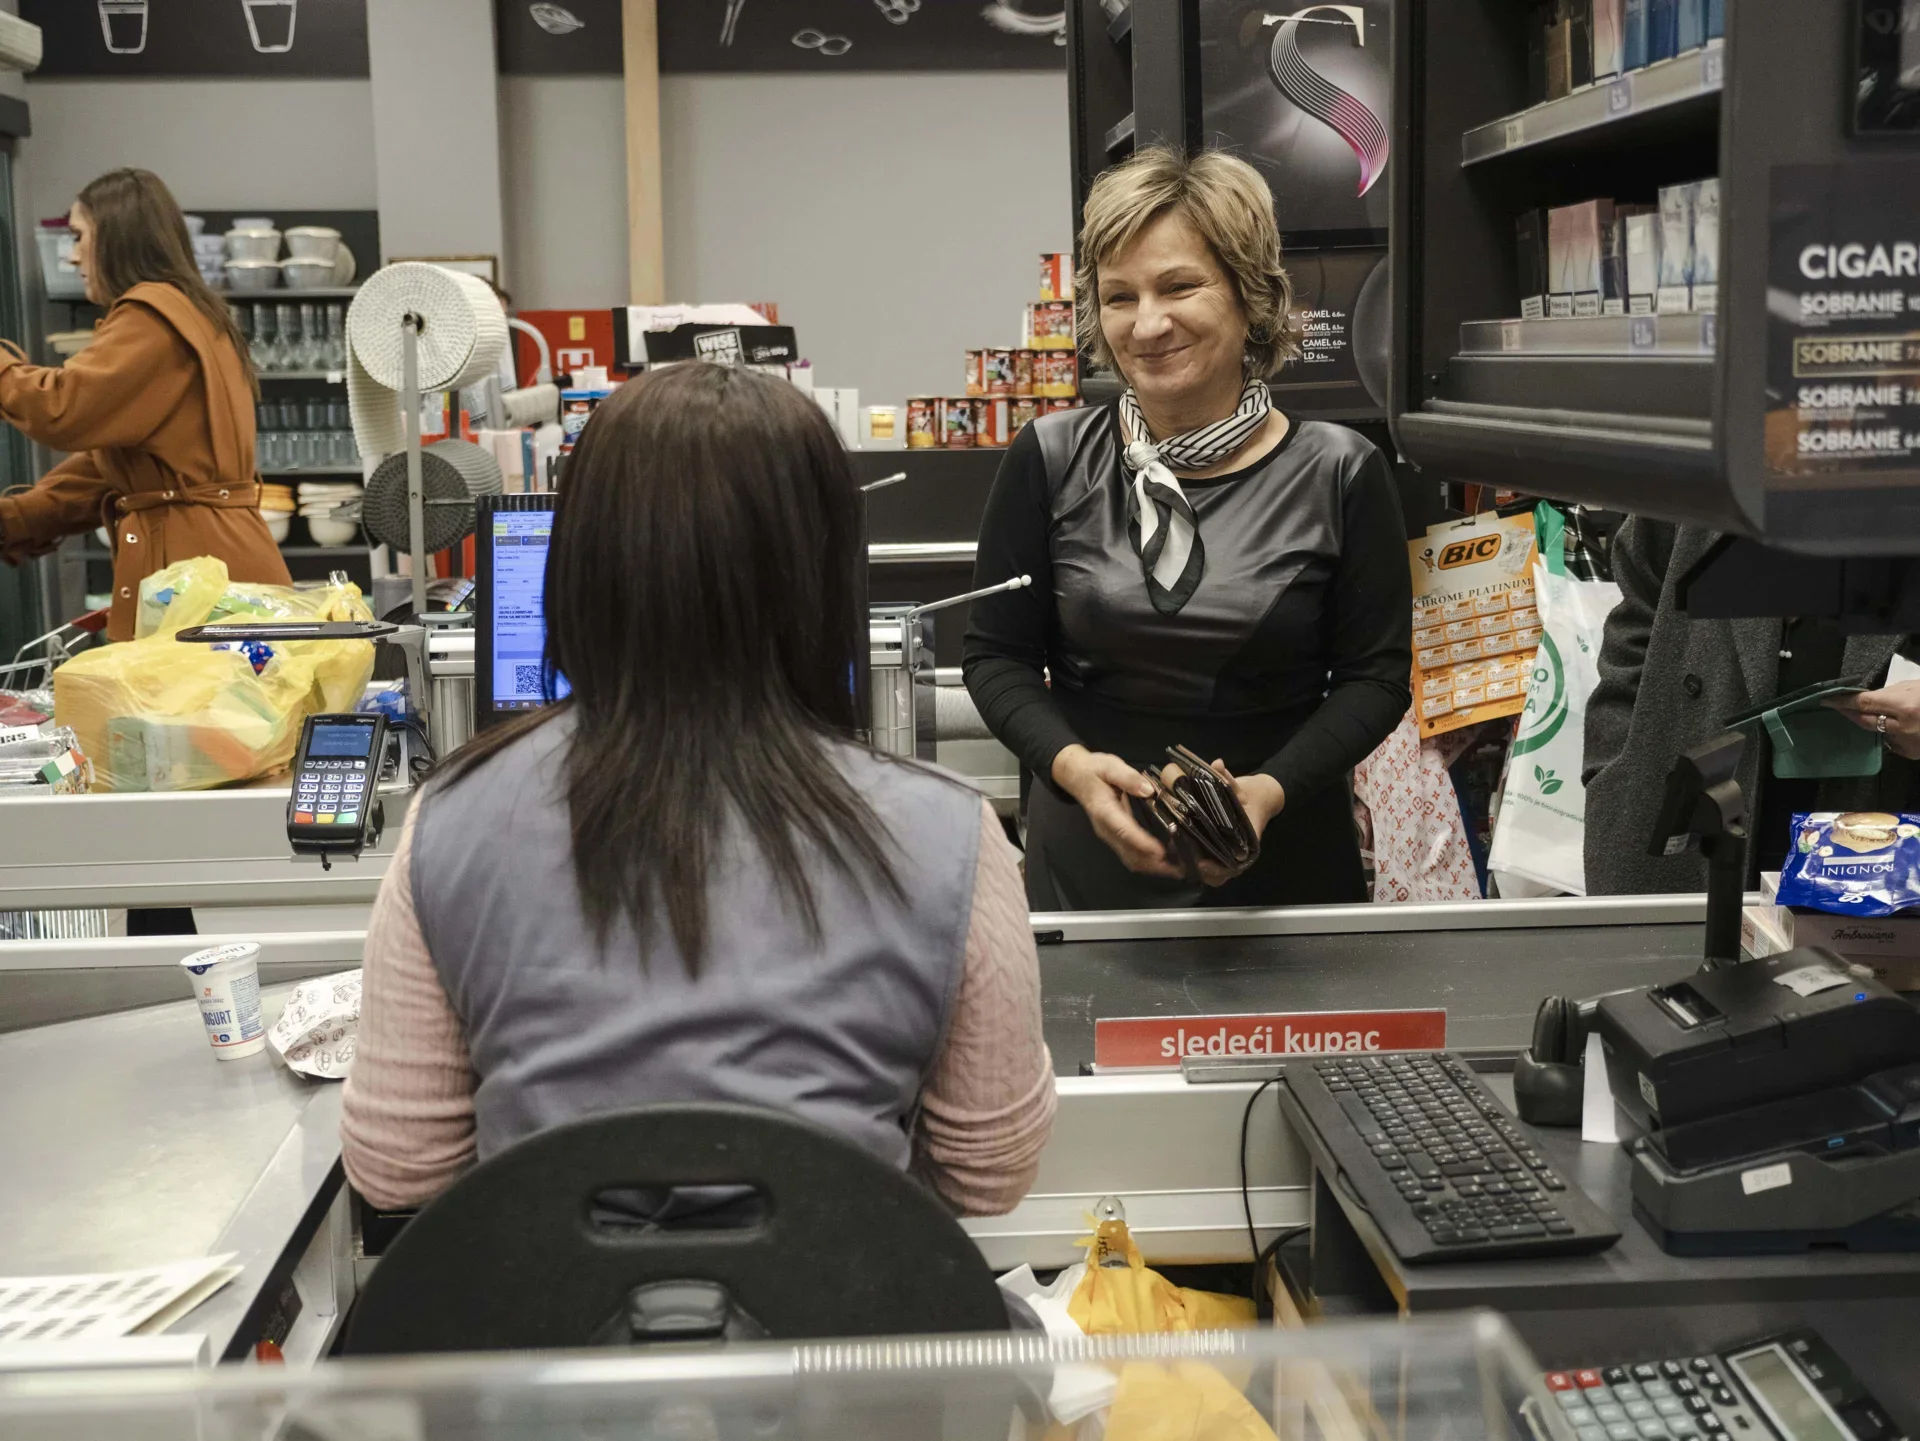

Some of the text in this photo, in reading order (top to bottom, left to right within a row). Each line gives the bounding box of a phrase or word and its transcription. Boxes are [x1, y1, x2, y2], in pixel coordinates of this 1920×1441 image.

[1799, 241, 1920, 279] CIGAR
[1800, 291, 1903, 314] SOBRANIE
[1302, 310, 1330, 319] CAMEL
[1302, 323, 1331, 331] CAMEL
[698, 332, 738, 352] WISE
[1302, 338, 1331, 347] CAMEL
[1303, 352, 1315, 360] LD
[1800, 342, 1902, 363] SOBRANIE
[1798, 385, 1901, 408] SOBRANIE
[1797, 428, 1900, 452] SOBRANIE
[1413, 578, 1532, 609] CHROME PLATINUM
[1422, 669, 1431, 681] 5
[1534, 668, 1549, 682] O
[1530, 683, 1540, 694] M
[1524, 698, 1536, 713] A
[1541, 801, 1585, 823] biorazgradiva
[1821, 864, 1894, 876] RONDINI
[1831, 929, 1896, 940] Ambrosiana
[1161, 1025, 1380, 1058] sledeći kupac
